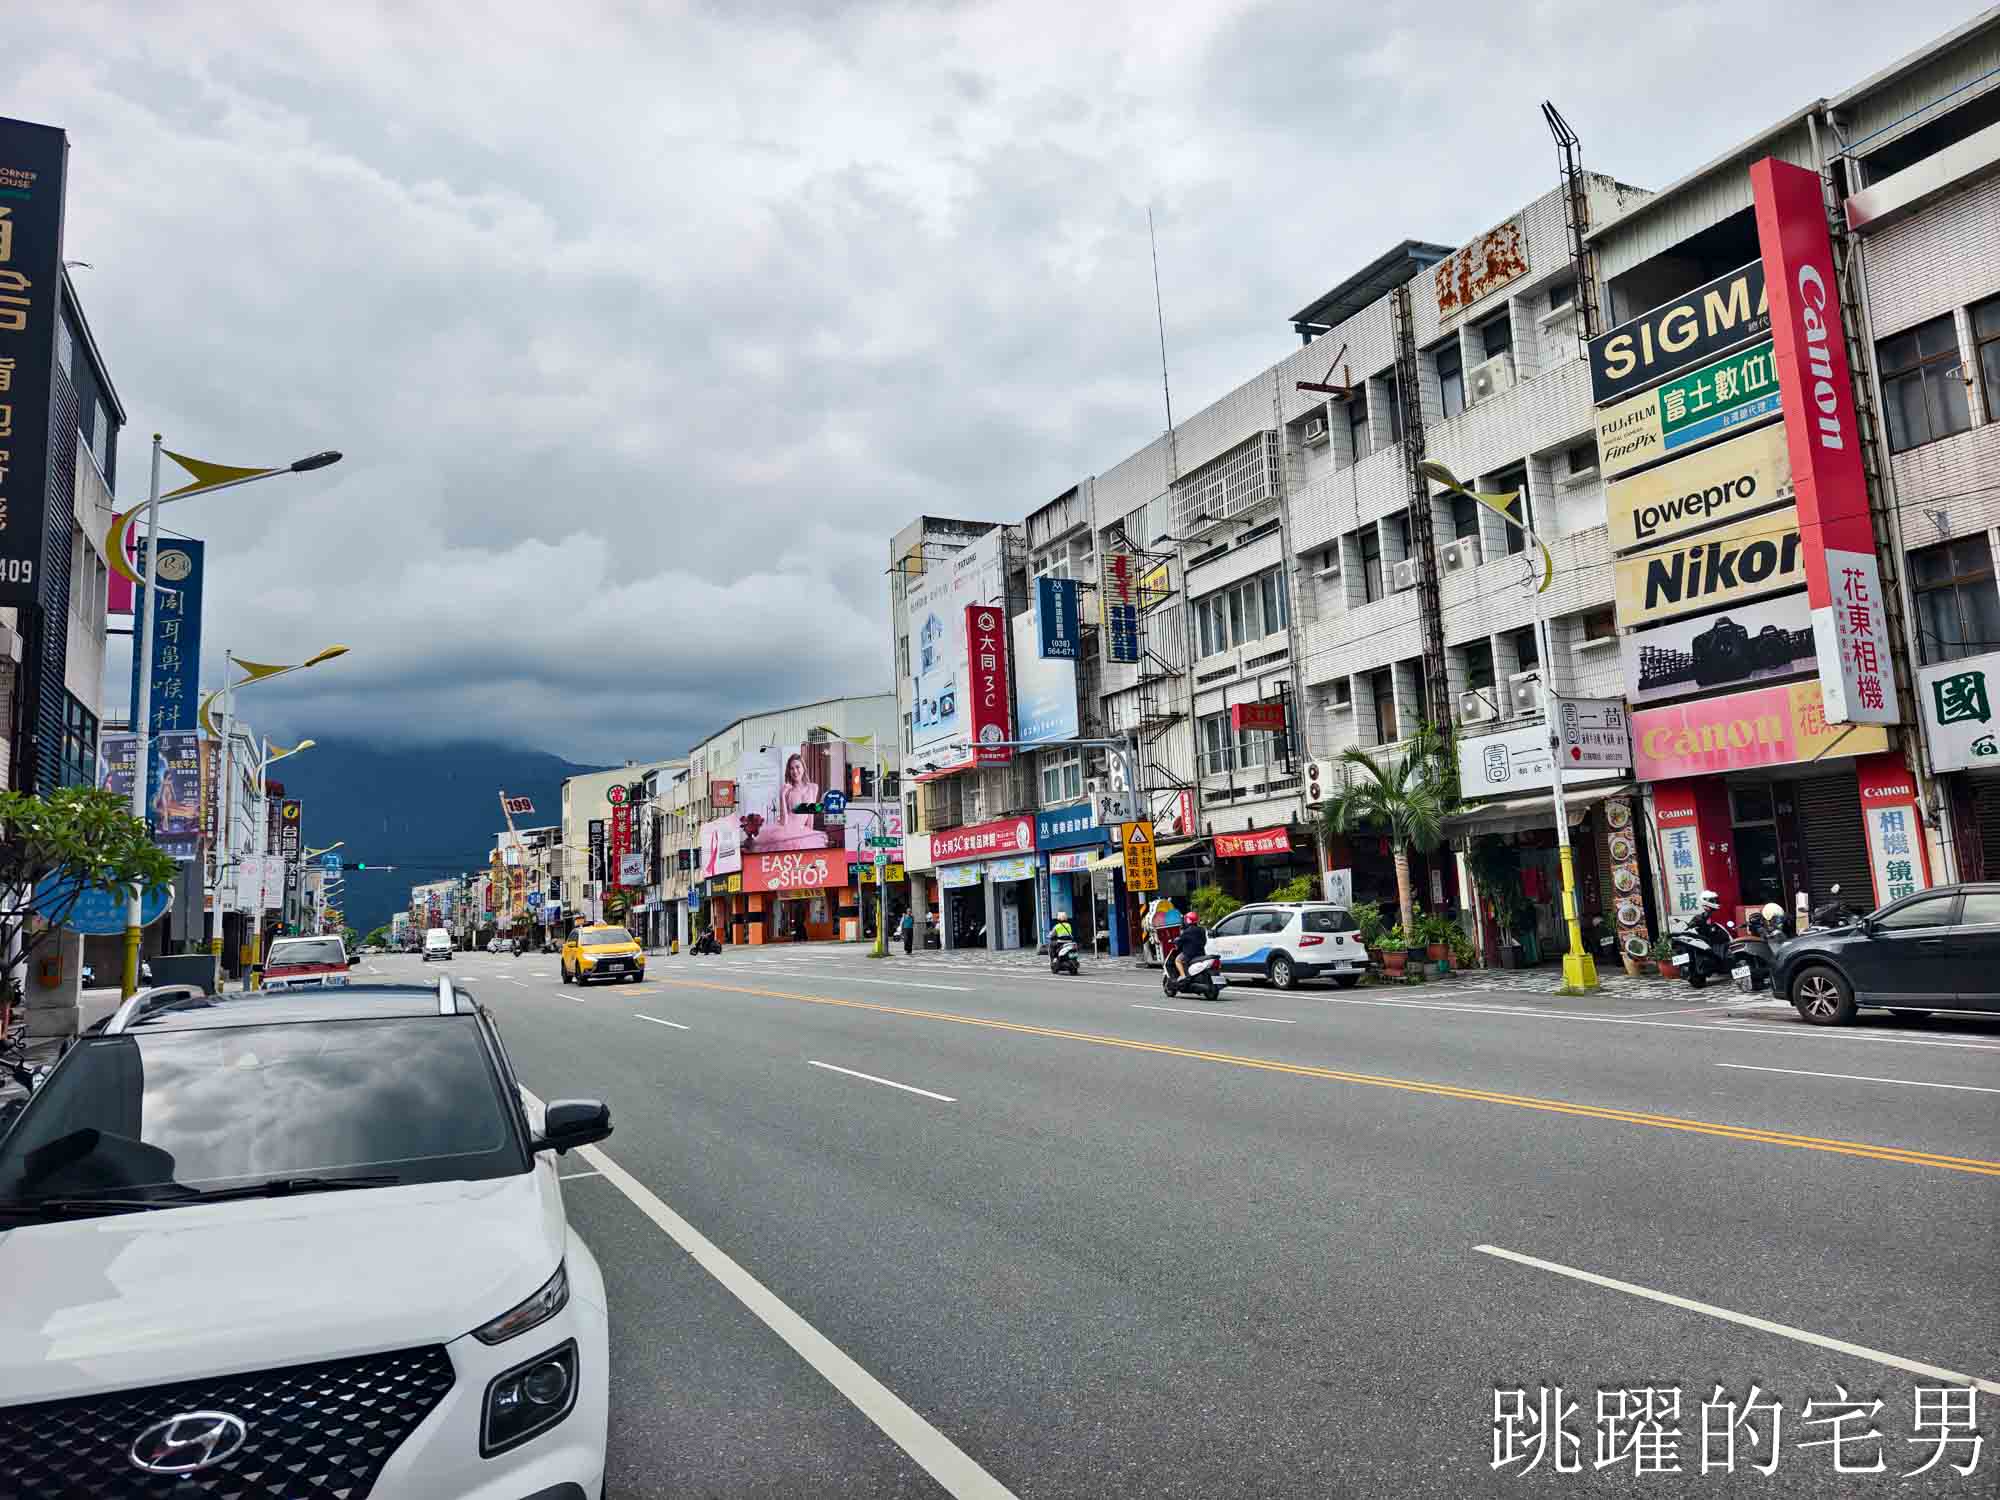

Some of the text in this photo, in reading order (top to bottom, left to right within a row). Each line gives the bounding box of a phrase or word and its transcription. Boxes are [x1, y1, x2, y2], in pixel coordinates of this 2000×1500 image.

[1798, 263, 1845, 451] Canon
[1601, 405, 1657, 437] FUJIFILM
[1605, 432, 1657, 463] FinePix
[1633, 474, 1756, 539] Lowepro
[1841, 567, 1885, 710] 花東相機
[1931, 671, 1992, 726] 國
[1642, 714, 1783, 761] Canon
[507, 799, 532, 812] 199
[1863, 784, 1910, 799] Canon
[1657, 807, 1694, 821] Canon
[761, 853, 803, 873] EASY
[779, 863, 829, 887] SHOP
[1668, 830, 1699, 912] 手機平板
